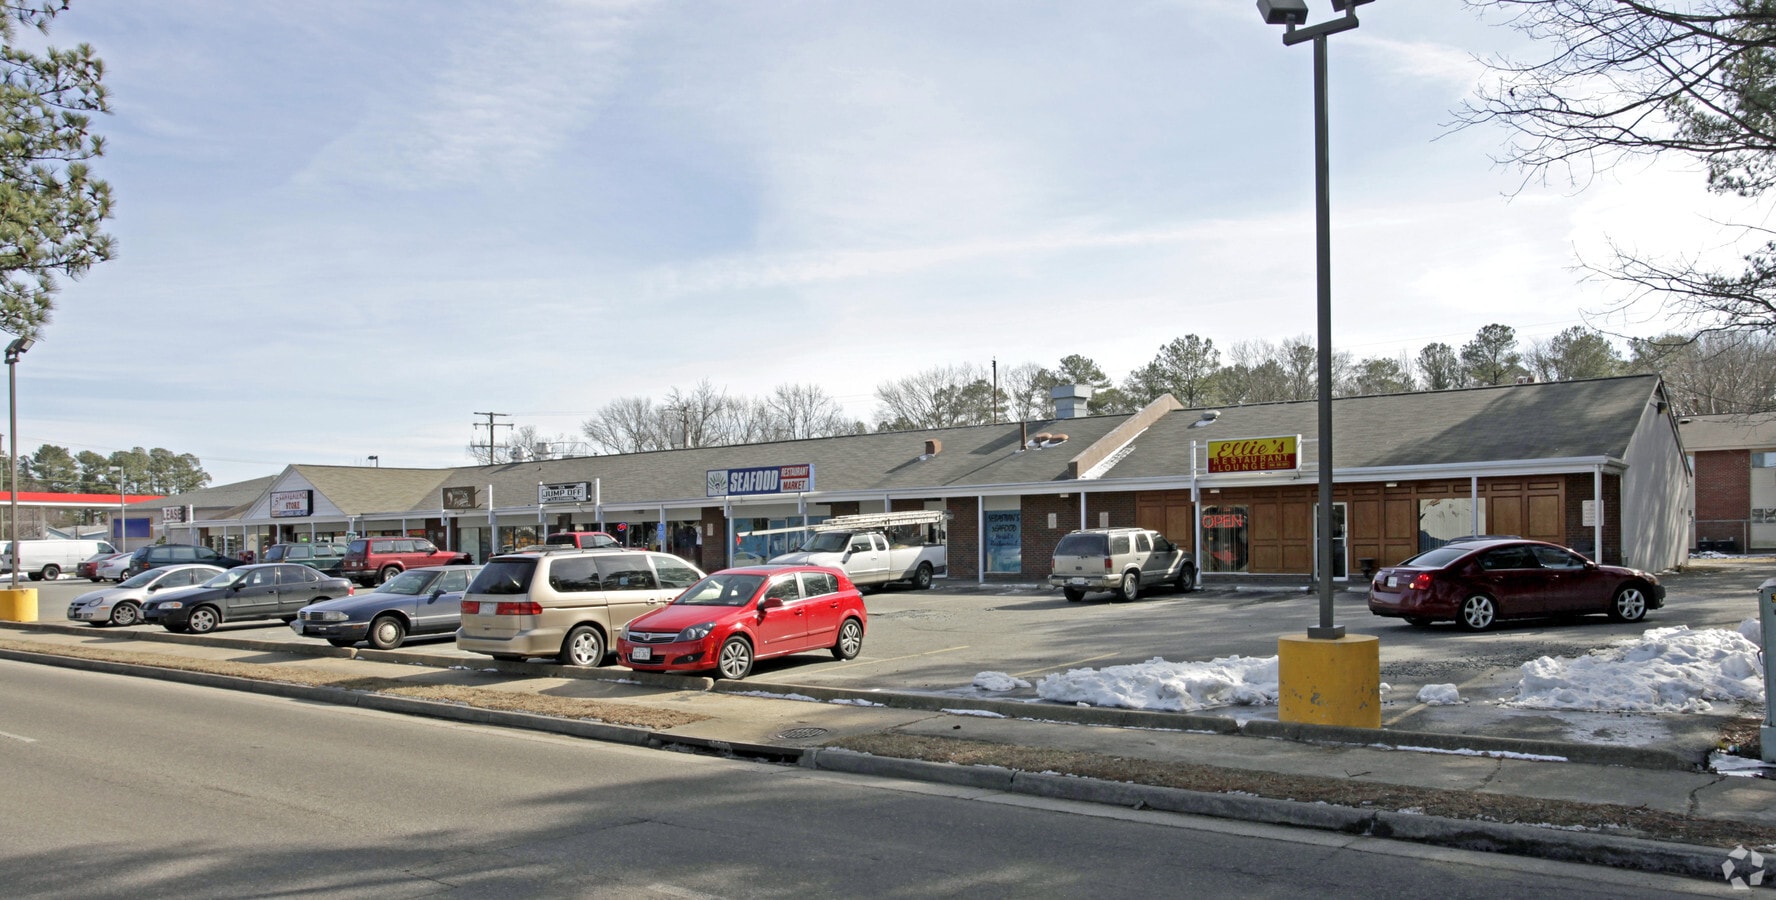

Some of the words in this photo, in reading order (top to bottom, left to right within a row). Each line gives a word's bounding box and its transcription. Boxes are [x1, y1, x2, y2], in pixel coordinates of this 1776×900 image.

[1217, 440, 1285, 458] Ellie's
[1213, 454, 1288, 465] RESTAURANT
[781, 466, 809, 477] RESTAURANT
[1218, 462, 1266, 472] LOUNGE
[729, 470, 779, 492] SEAFOOD
[783, 480, 805, 490] MARKET
[542, 489, 565, 497] JUMP
[567, 488, 582, 496] OFF
[285, 501, 300, 510] STORE
[163, 507, 182, 520] LEASE
[1202, 513, 1243, 528] OPEN
